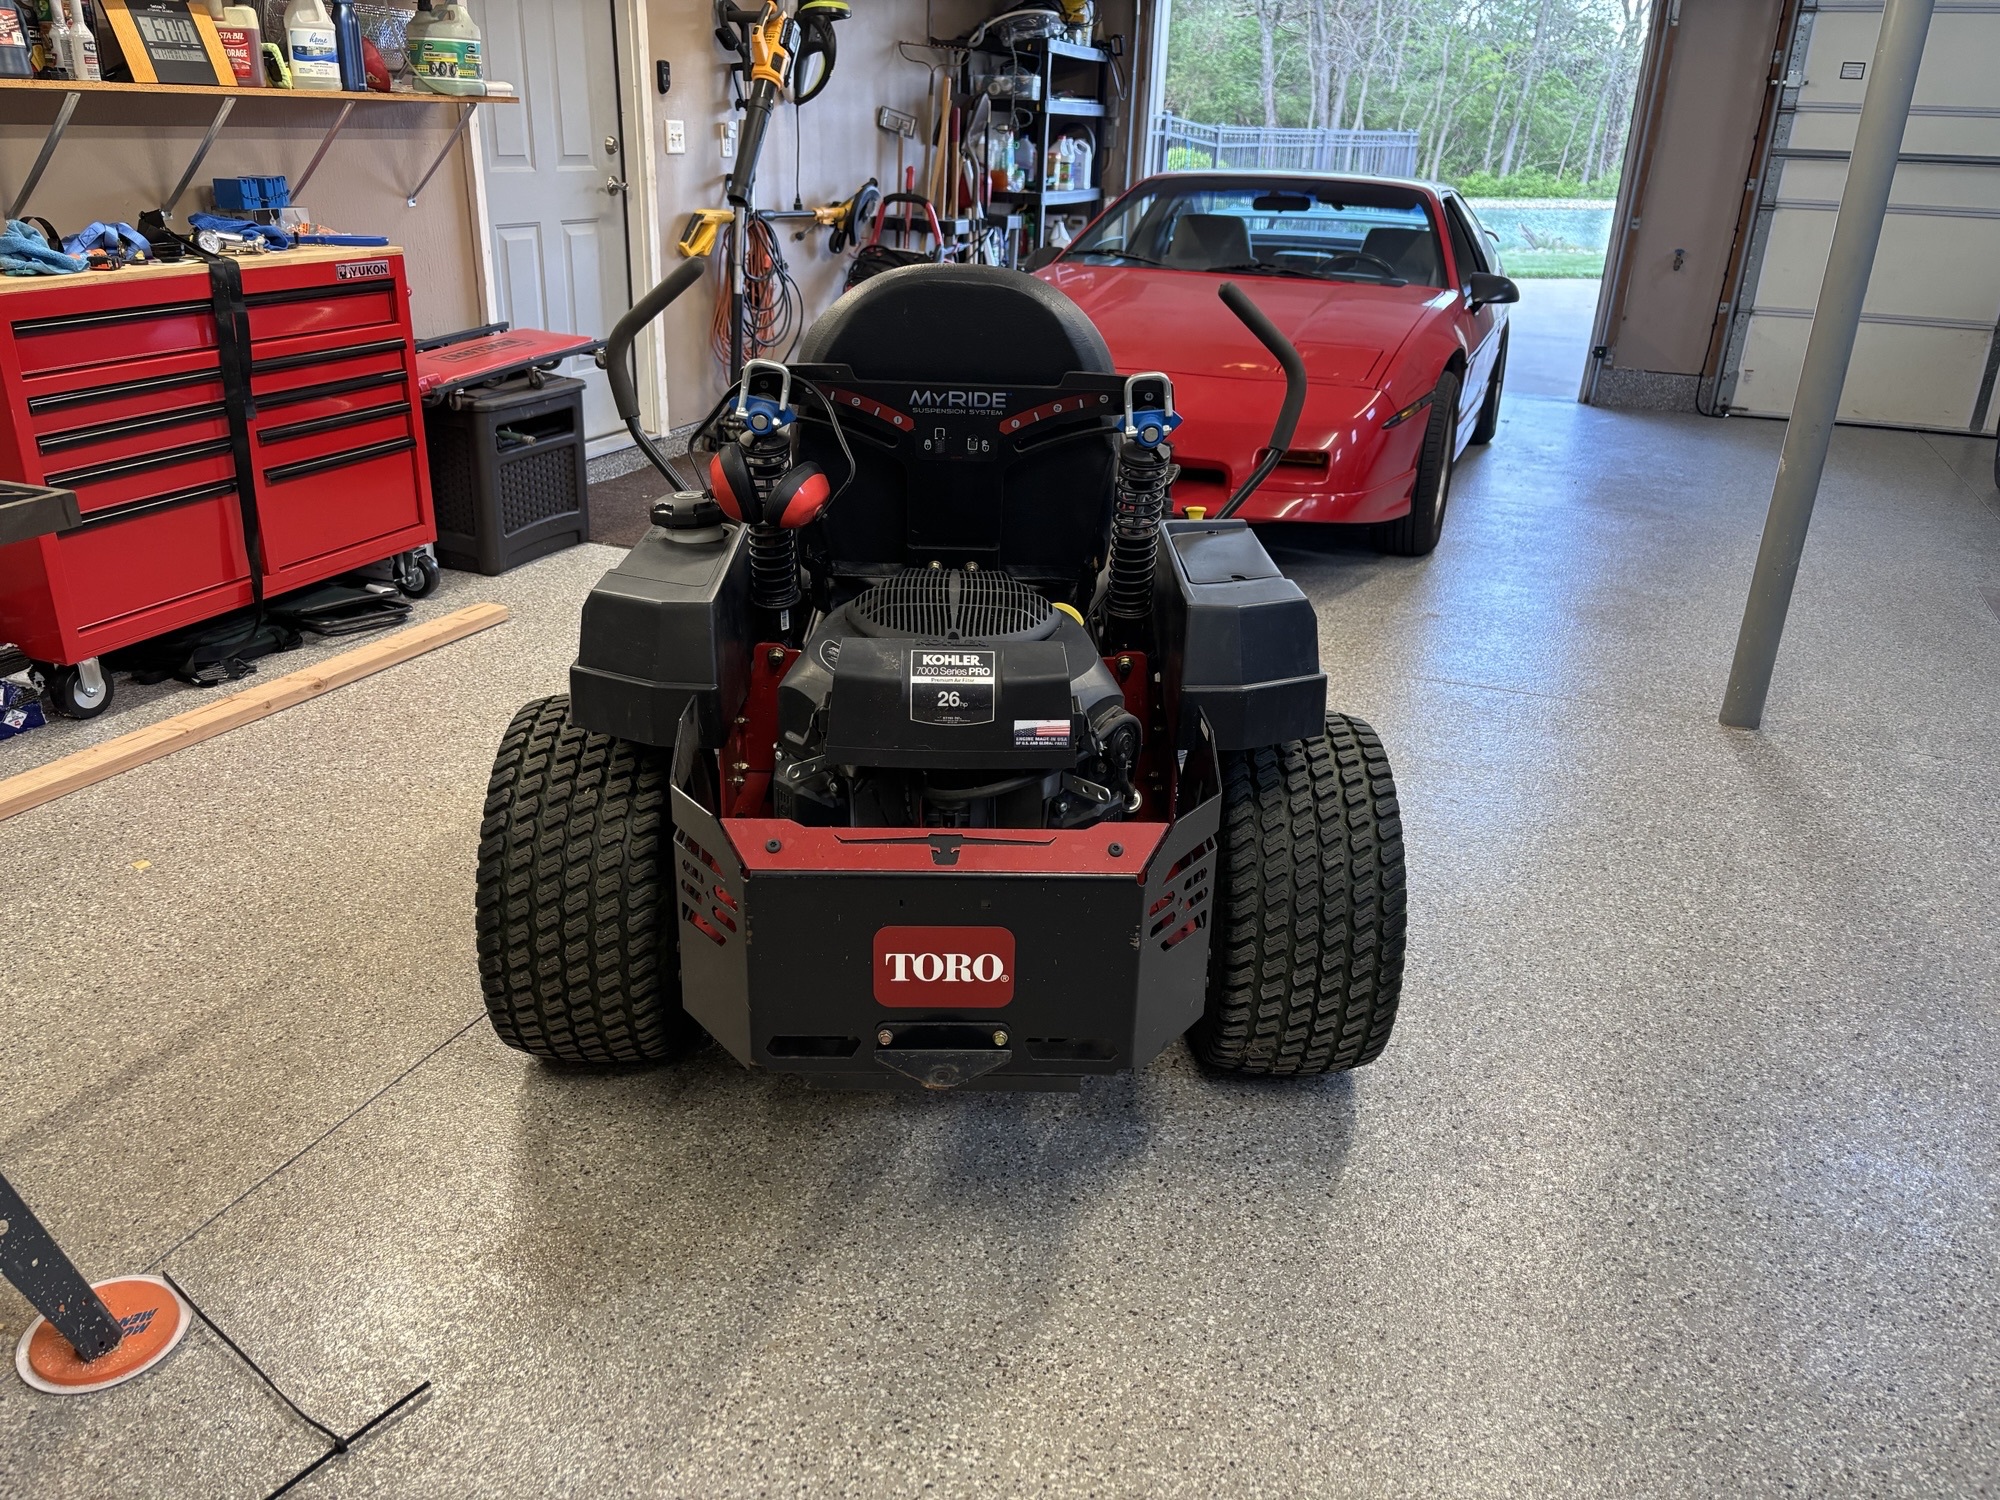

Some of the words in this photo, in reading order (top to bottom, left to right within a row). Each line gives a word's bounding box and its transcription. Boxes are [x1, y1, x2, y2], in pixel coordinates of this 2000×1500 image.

[219, 31, 245, 40] STA-BIL
[226, 48, 248, 58] ORAGE
[350, 264, 388, 276] YUKON
[912, 407, 966, 415] SUSPENSION
[969, 408, 1003, 416] SYSTEM
[916, 666, 939, 676] 7000
[939, 666, 967, 676] Series
[968, 667, 991, 676] PRO
[937, 690, 960, 707] 26
[885, 953, 1004, 983] TORO
